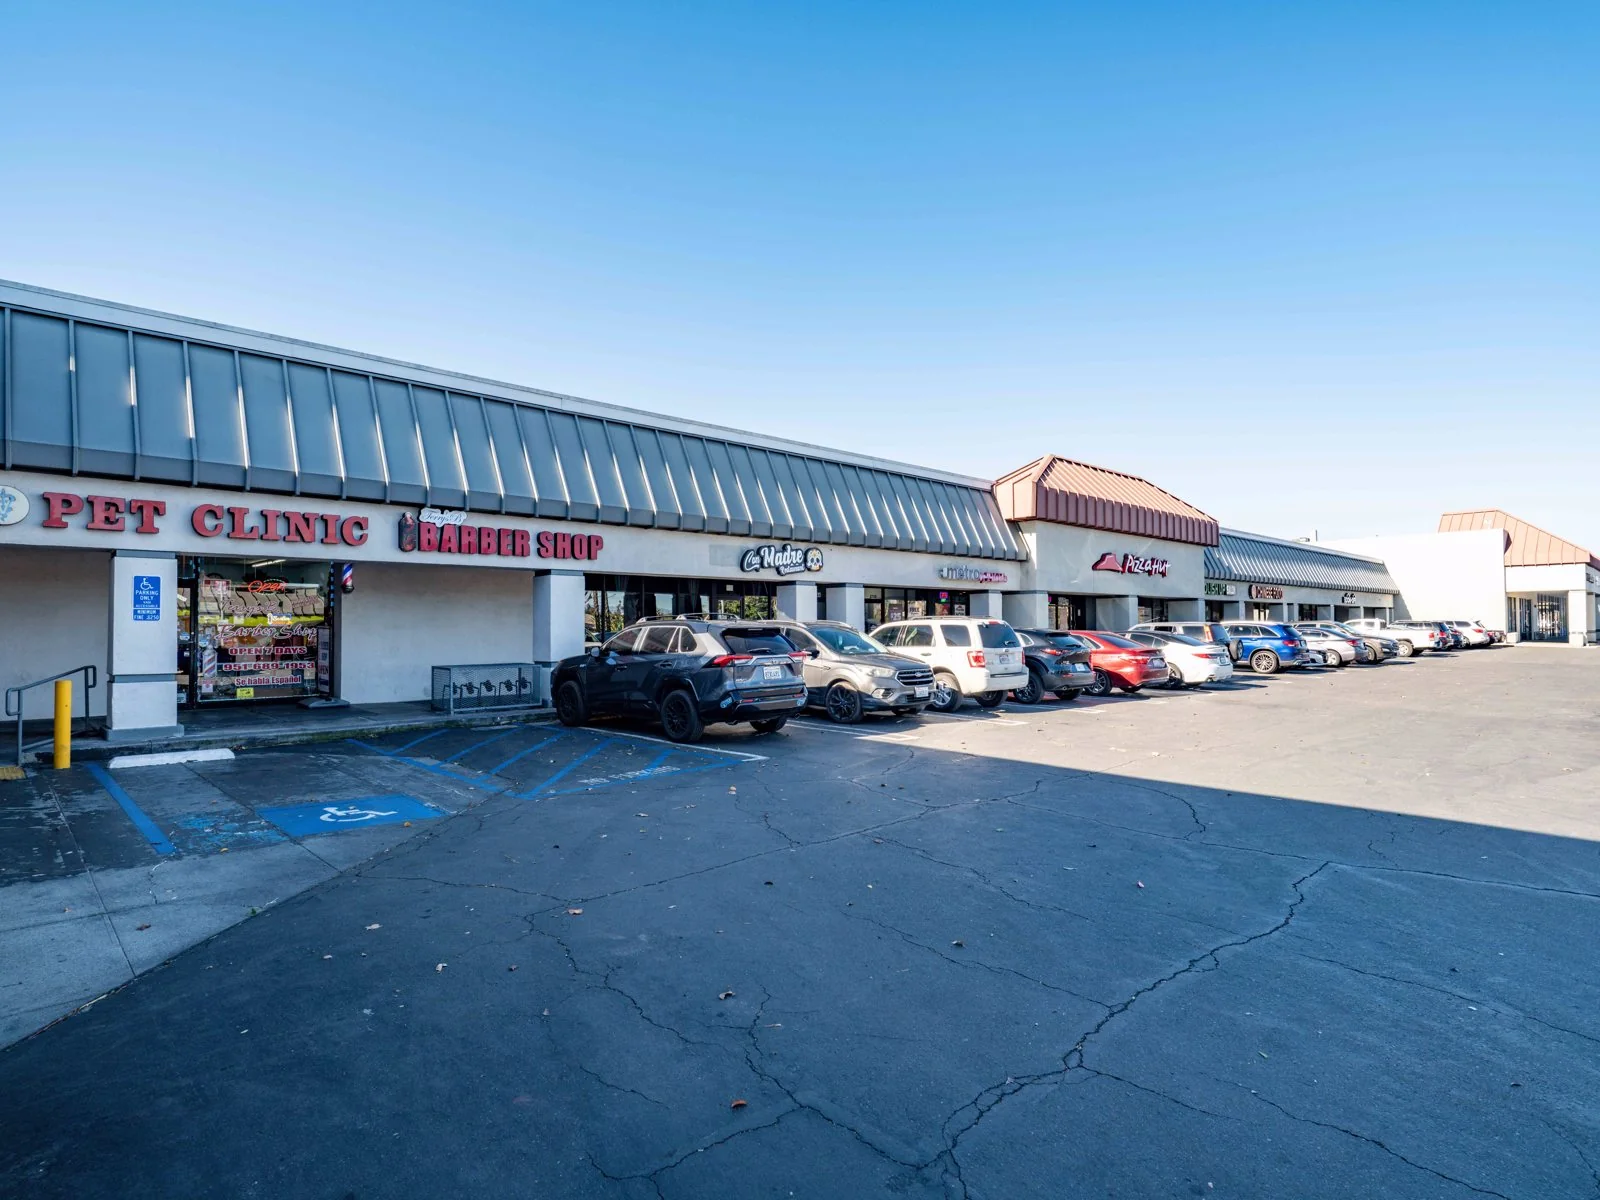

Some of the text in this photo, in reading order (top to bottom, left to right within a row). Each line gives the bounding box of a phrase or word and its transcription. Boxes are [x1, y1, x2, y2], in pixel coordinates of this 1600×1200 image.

[42, 492, 369, 546] PET CLINIC
[418, 522, 604, 560] BARBER SHOP
[744, 545, 804, 571] Con Madre
[1124, 554, 1172, 576] Pizza Hut
[946, 565, 980, 580] metro
[214, 623, 317, 641] Barber Shop
[229, 646, 308, 656] OPEN 7 DAYS
[235, 678, 246, 686] Se
[247, 676, 270, 685] habla
